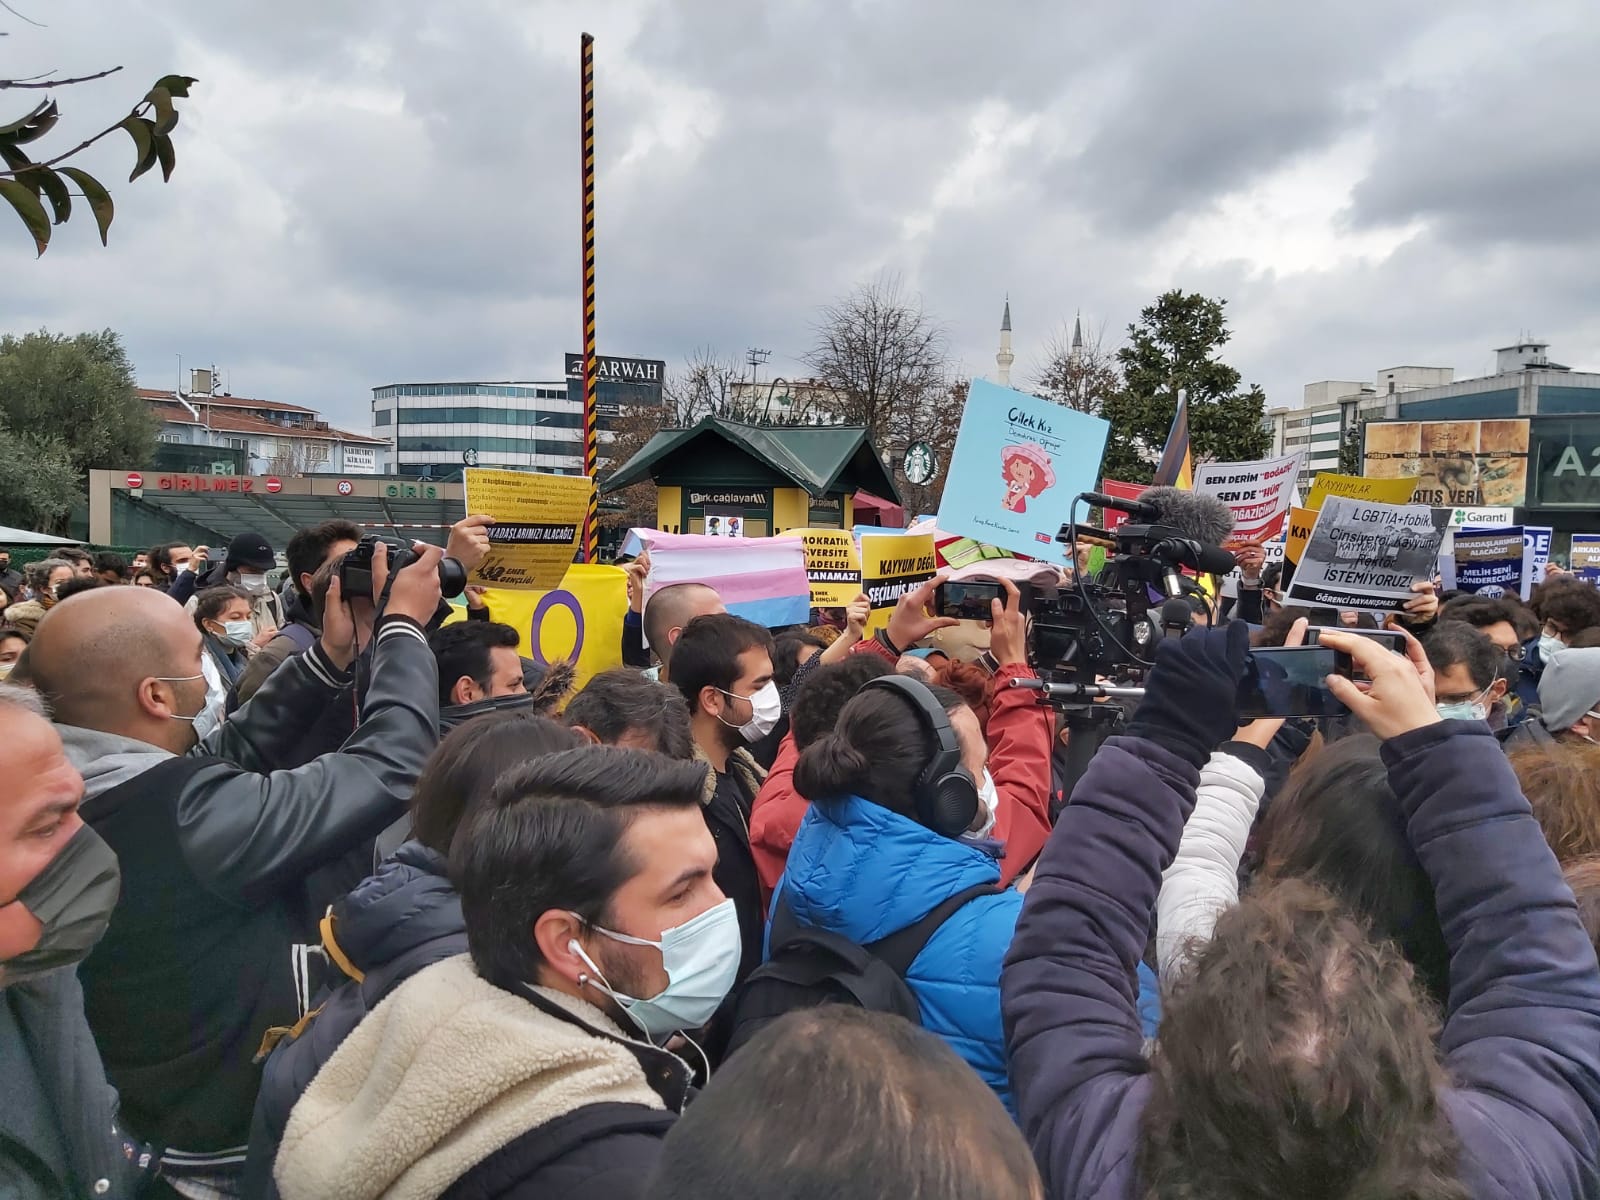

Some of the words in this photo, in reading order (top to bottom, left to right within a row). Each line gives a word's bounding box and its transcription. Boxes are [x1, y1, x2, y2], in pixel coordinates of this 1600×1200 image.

[598, 361, 657, 380] ARWAH
[158, 474, 253, 492] GİRİLMEZ
[1206, 476, 1226, 485] BEN
[1228, 472, 1258, 484] DERİM
[386, 483, 436, 498] GİRİŞ
[1316, 478, 1372, 494] KAYYUMLAR
[1217, 492, 1240, 501] SEN
[1242, 490, 1256, 500] DE
[1408, 489, 1444, 505] ATIŞ
[1468, 512, 1506, 522] Garanti
[488, 527, 543, 540] RKADAŞLARIMIZI
[543, 526, 574, 540] ALACAĞIZ
[802, 536, 849, 546] MOKRATİK
[1524, 534, 1549, 552] DE
[807, 546, 848, 557] İVERSİTE
[809, 560, 849, 568] ADELESİ
[880, 558, 914, 575] KAYYUM
[917, 552, 935, 570] DEĞİL
[1464, 568, 1490, 576] MELİH
[1492, 564, 1512, 574] SENİ
[808, 572, 858, 580] LANAMAZ!
[1324, 566, 1413, 588] İSTEMİYORUZ!
[1456, 572, 1520, 584] GÖNDERECEĞİZ
[1316, 593, 1350, 604] ÖĞRENCİ
